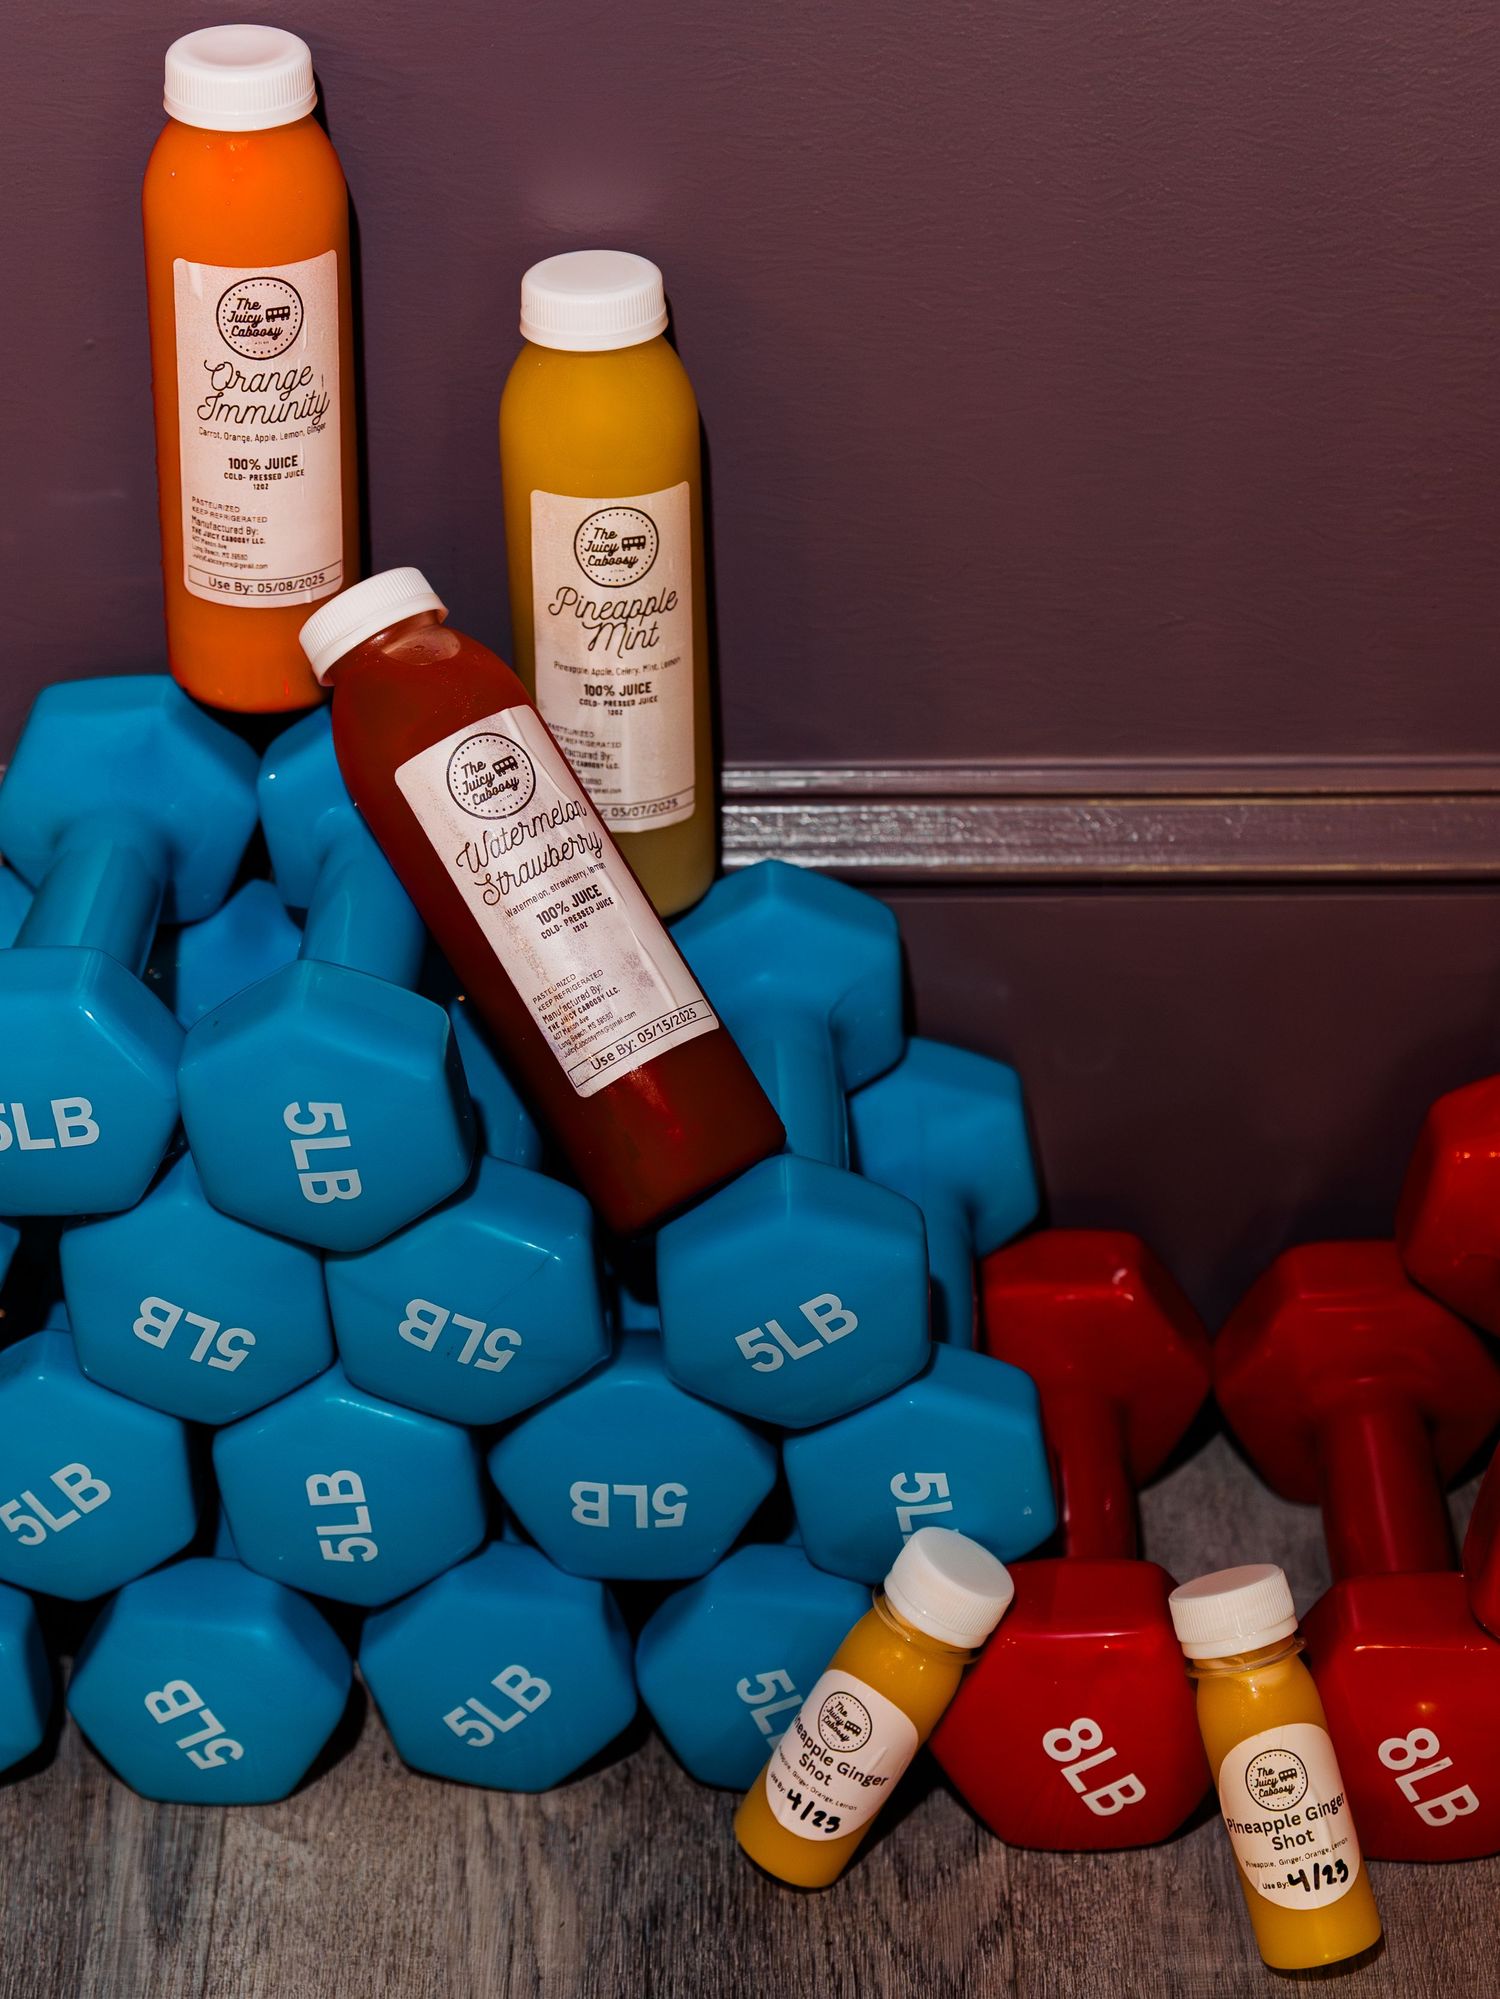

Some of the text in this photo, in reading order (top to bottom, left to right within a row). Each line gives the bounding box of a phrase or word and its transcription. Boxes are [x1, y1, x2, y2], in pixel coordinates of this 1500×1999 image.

[226, 310, 263, 328] Juicy
[237, 298, 262, 310] The
[231, 325, 283, 340] Caboosy
[204, 359, 313, 401] Orange
[197, 390, 330, 426] Immunity
[199, 427, 222, 440] Carrot,
[224, 432, 252, 443] Orange,
[307, 422, 326, 435] Ginger
[224, 469, 305, 481] COLD- PRESSED JUICE
[228, 455, 298, 471] 100% JUICE
[192, 496, 240, 513] PASTEURIZED
[192, 506, 268, 524] KEEP REFRIGERATED
[191, 515, 259, 537] Manufactured By:
[593, 527, 618, 540] The
[584, 541, 620, 557] Juicy
[588, 555, 639, 569] Caboosy
[208, 573, 325, 595] Use By: 05/08/2025
[548, 586, 678, 627] Pineapple
[582, 621, 660, 659] Mint
[579, 695, 658, 707] COLD- PRESSED JUICE
[584, 681, 652, 696] 100% JUICE
[461, 761, 486, 778] The
[462, 770, 495, 796] Juicy
[472, 777, 519, 806] Caboosy
[611, 798, 678, 817] 05/07/2025
[456, 800, 587, 874] Watermelon
[474, 831, 602, 906] Strawberry
[505, 862, 606, 918] Watermelon, strawberry, lemon
[536, 884, 602, 926] 100% JUICE
[540, 896, 614, 940] COLD- PRESSED JUICE
[532, 973, 576, 1004] PASTEURIZED
[538, 969, 604, 1012] KEEP REFRIGERATED
[541, 984, 604, 1024] Manufactured By:
[548, 986, 621, 1033] THE JUICY CABOOSY LLC.
[580, 1015, 590, 1025] Ave
[589, 1007, 697, 1071] Use By: 05/15/2025
[0, 1097, 99, 1151] LB
[284, 1103, 361, 1203] 5LB
[133, 1297, 255, 1371] 5LB
[399, 1299, 521, 1371] 5LB
[736, 1294, 857, 1371] 5LB
[0, 1464, 110, 1544] 5LB
[306, 1471, 377, 1561] 5LB
[571, 1482, 686, 1527] 5LB
[890, 1472, 953, 1544] 5L
[444, 1666, 550, 1746] 5LB
[736, 1669, 803, 1750] 5L
[826, 1706, 844, 1727] Juicy
[835, 1701, 848, 1718] The
[145, 1680, 243, 1769] 5LB
[821, 1715, 851, 1743] Caboosy
[794, 1717, 834, 1767] neapple
[836, 1761, 889, 1788] Ginger
[1043, 1718, 1145, 1815] 8LB
[799, 1753, 833, 1786] Shot
[1254, 1777, 1278, 1788] Juicy
[1257, 1767, 1275, 1778] The
[1379, 1728, 1479, 1825] 8LB
[1258, 1783, 1295, 1798] Caboosy
[1226, 1792, 1345, 1837] Pineapple Ginger
[1272, 1829, 1315, 1851] Shot
[1278, 1856, 1304, 1866] Ginger,
[1304, 1848, 1332, 1860] Orange,
[1331, 1837, 1349, 1851] Lemon
[1277, 1881, 1290, 1889] By:
[1287, 1858, 1349, 1892] 4/23
